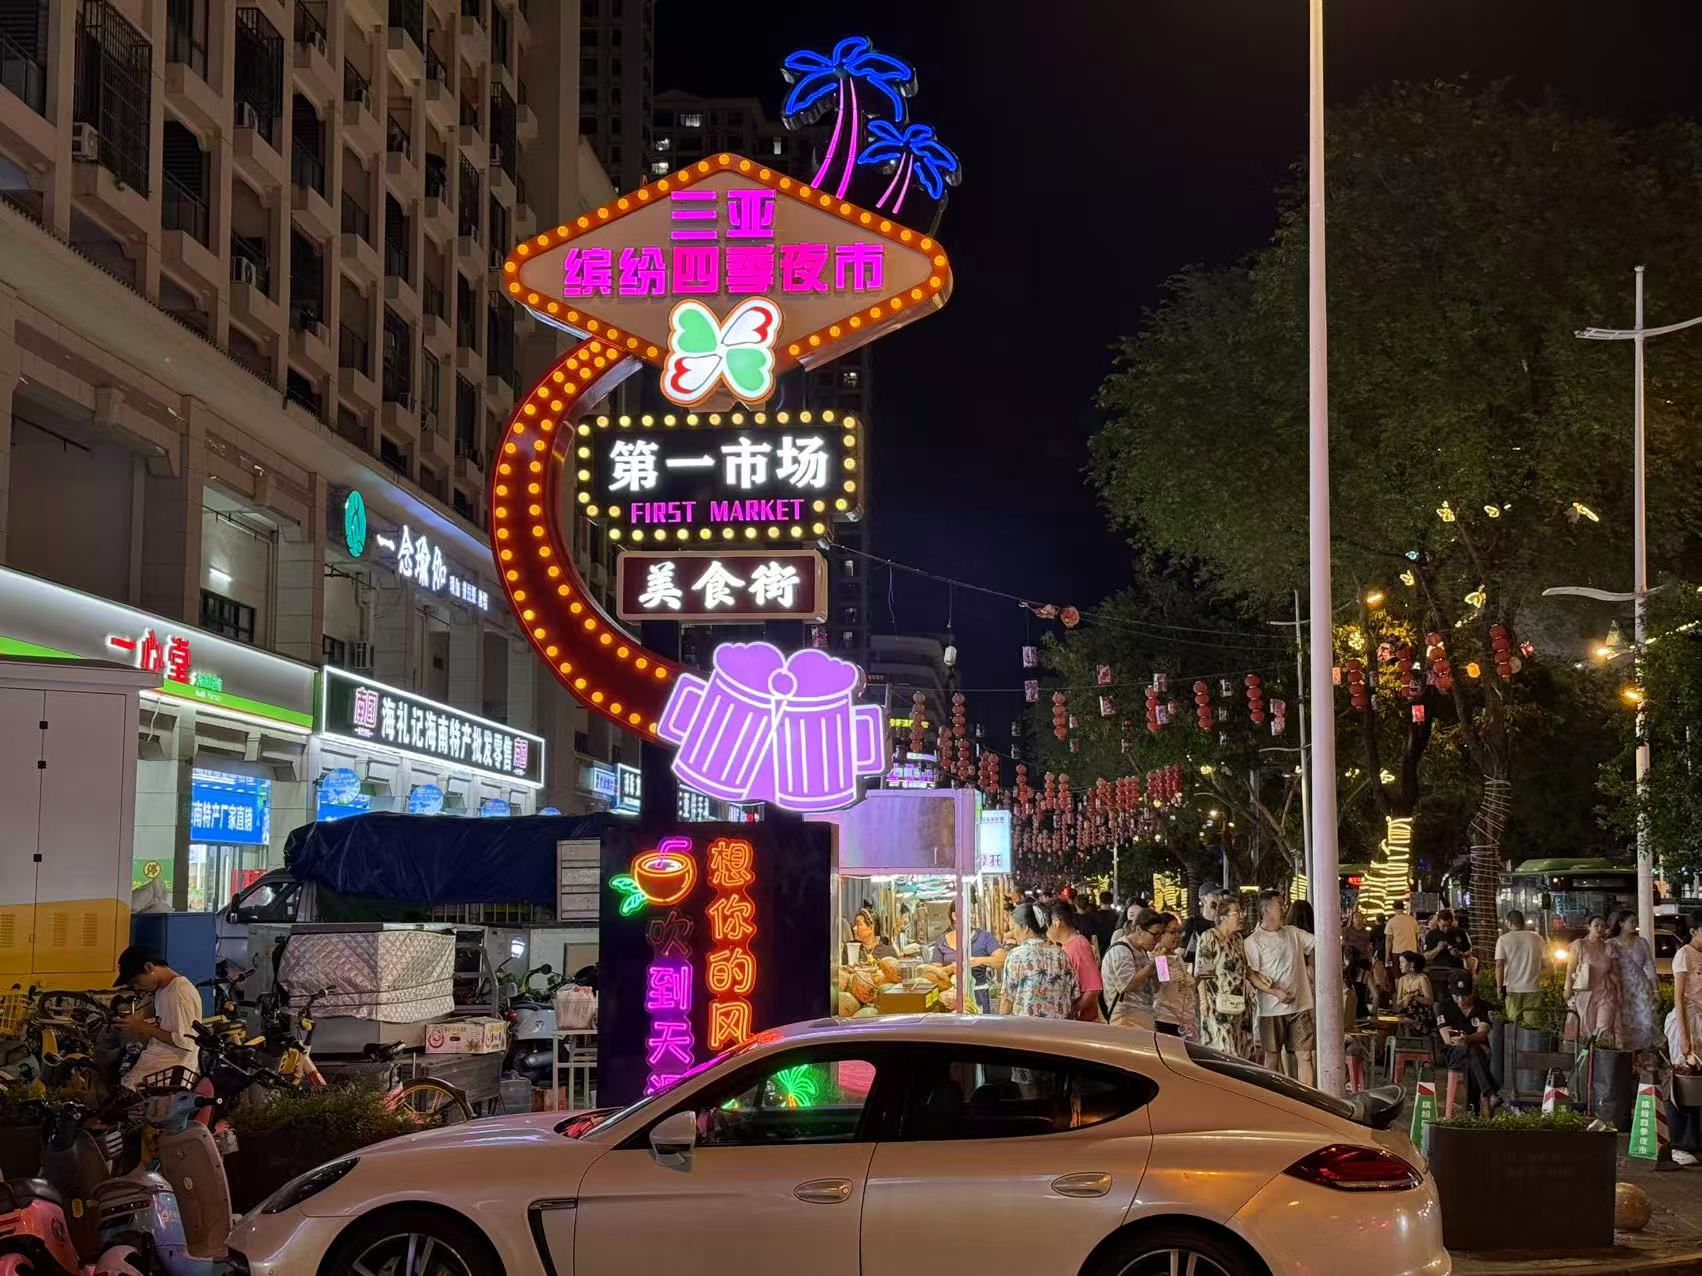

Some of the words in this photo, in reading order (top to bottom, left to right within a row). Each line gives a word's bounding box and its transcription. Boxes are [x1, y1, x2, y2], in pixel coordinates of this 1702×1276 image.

[670, 188, 777, 240] 三亚
[562, 242, 886, 297] 缤纷四季夜市
[608, 435, 831, 491] 第一市场
[630, 500, 697, 524] FIRST
[709, 498, 805, 522] MARKET
[638, 560, 801, 610] 美食街
[108, 628, 192, 684] 一心堂
[381, 696, 513, 772] 海礼记海南特产批发零售
[709, 839, 754, 1048] 想你的风
